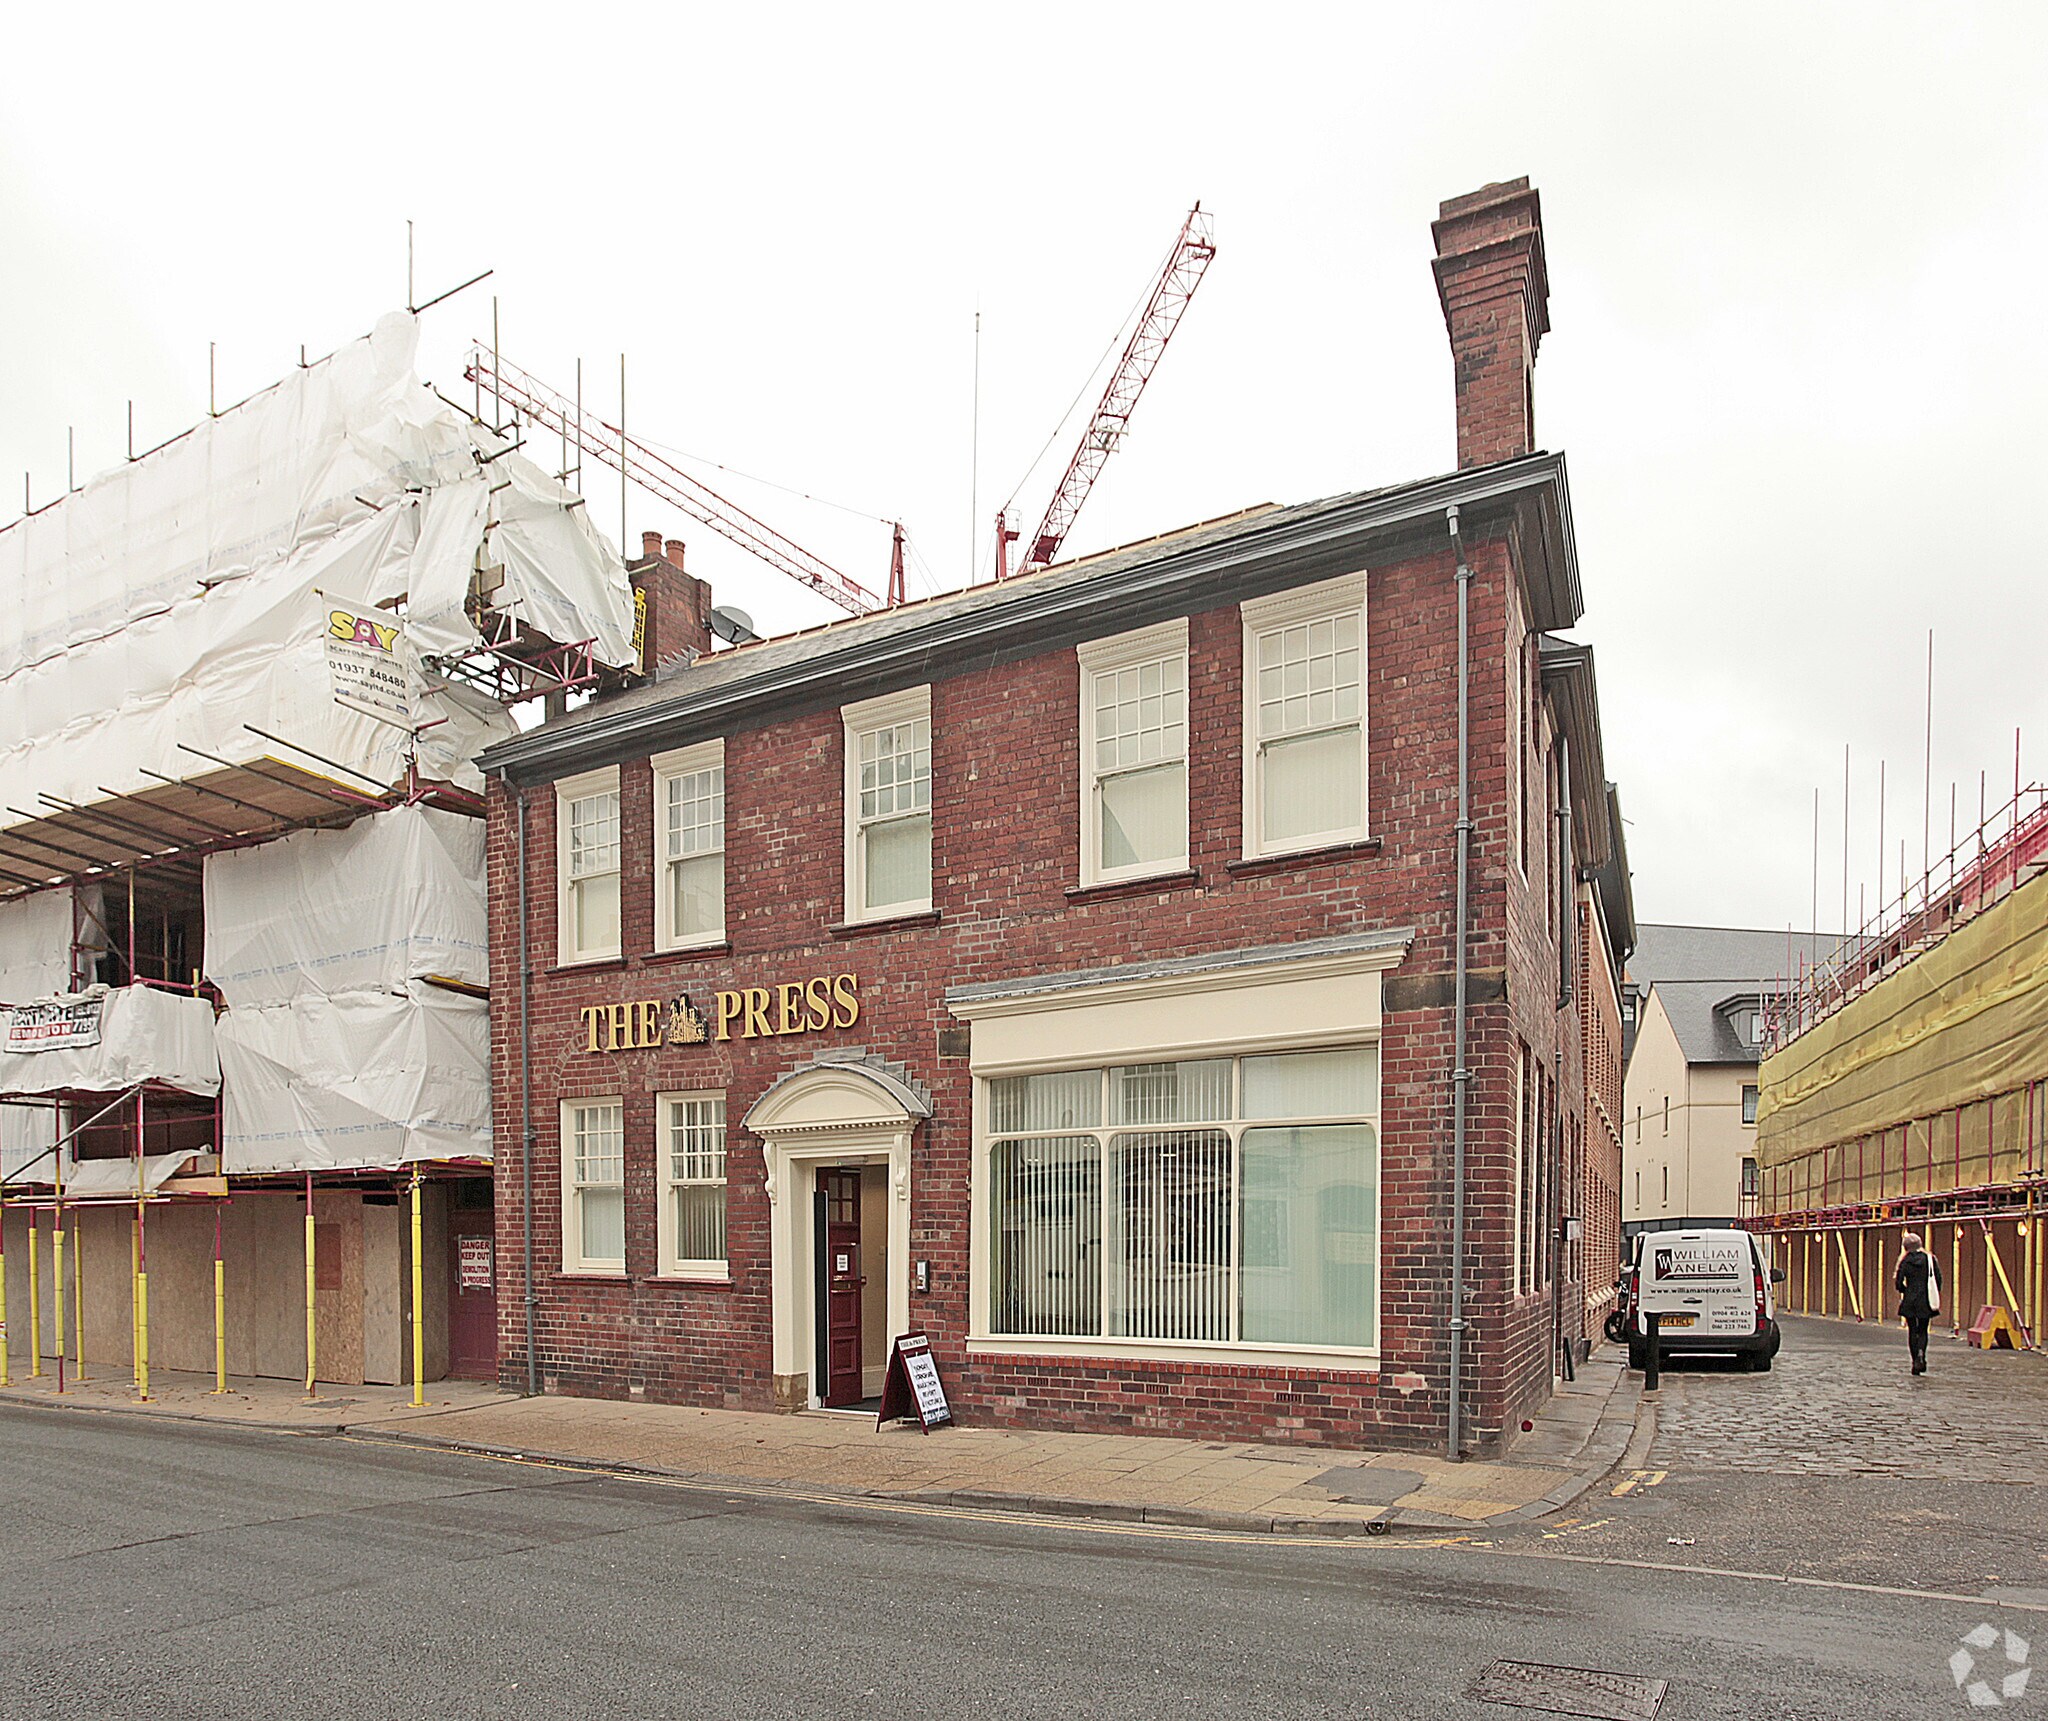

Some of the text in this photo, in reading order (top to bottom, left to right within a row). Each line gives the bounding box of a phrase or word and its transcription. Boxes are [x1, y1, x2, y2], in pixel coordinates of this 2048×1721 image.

[329, 610, 399, 653] SAY
[329, 660, 406, 689] 01937 848480
[334, 673, 407, 701] www.sayltd.co.uk
[580, 973, 860, 1052] THE PRESS
[461, 1241, 490, 1250] DANGER
[461, 1251, 490, 1260] KEEP OUT
[1674, 1249, 1739, 1260] WILLIAM
[462, 1265, 489, 1274] DEMOLITION
[1674, 1262, 1738, 1273] ANELAY
[467, 1276, 491, 1284] PROGRESS
[1650, 1286, 1742, 1295] www.williamanelay.co.uk
